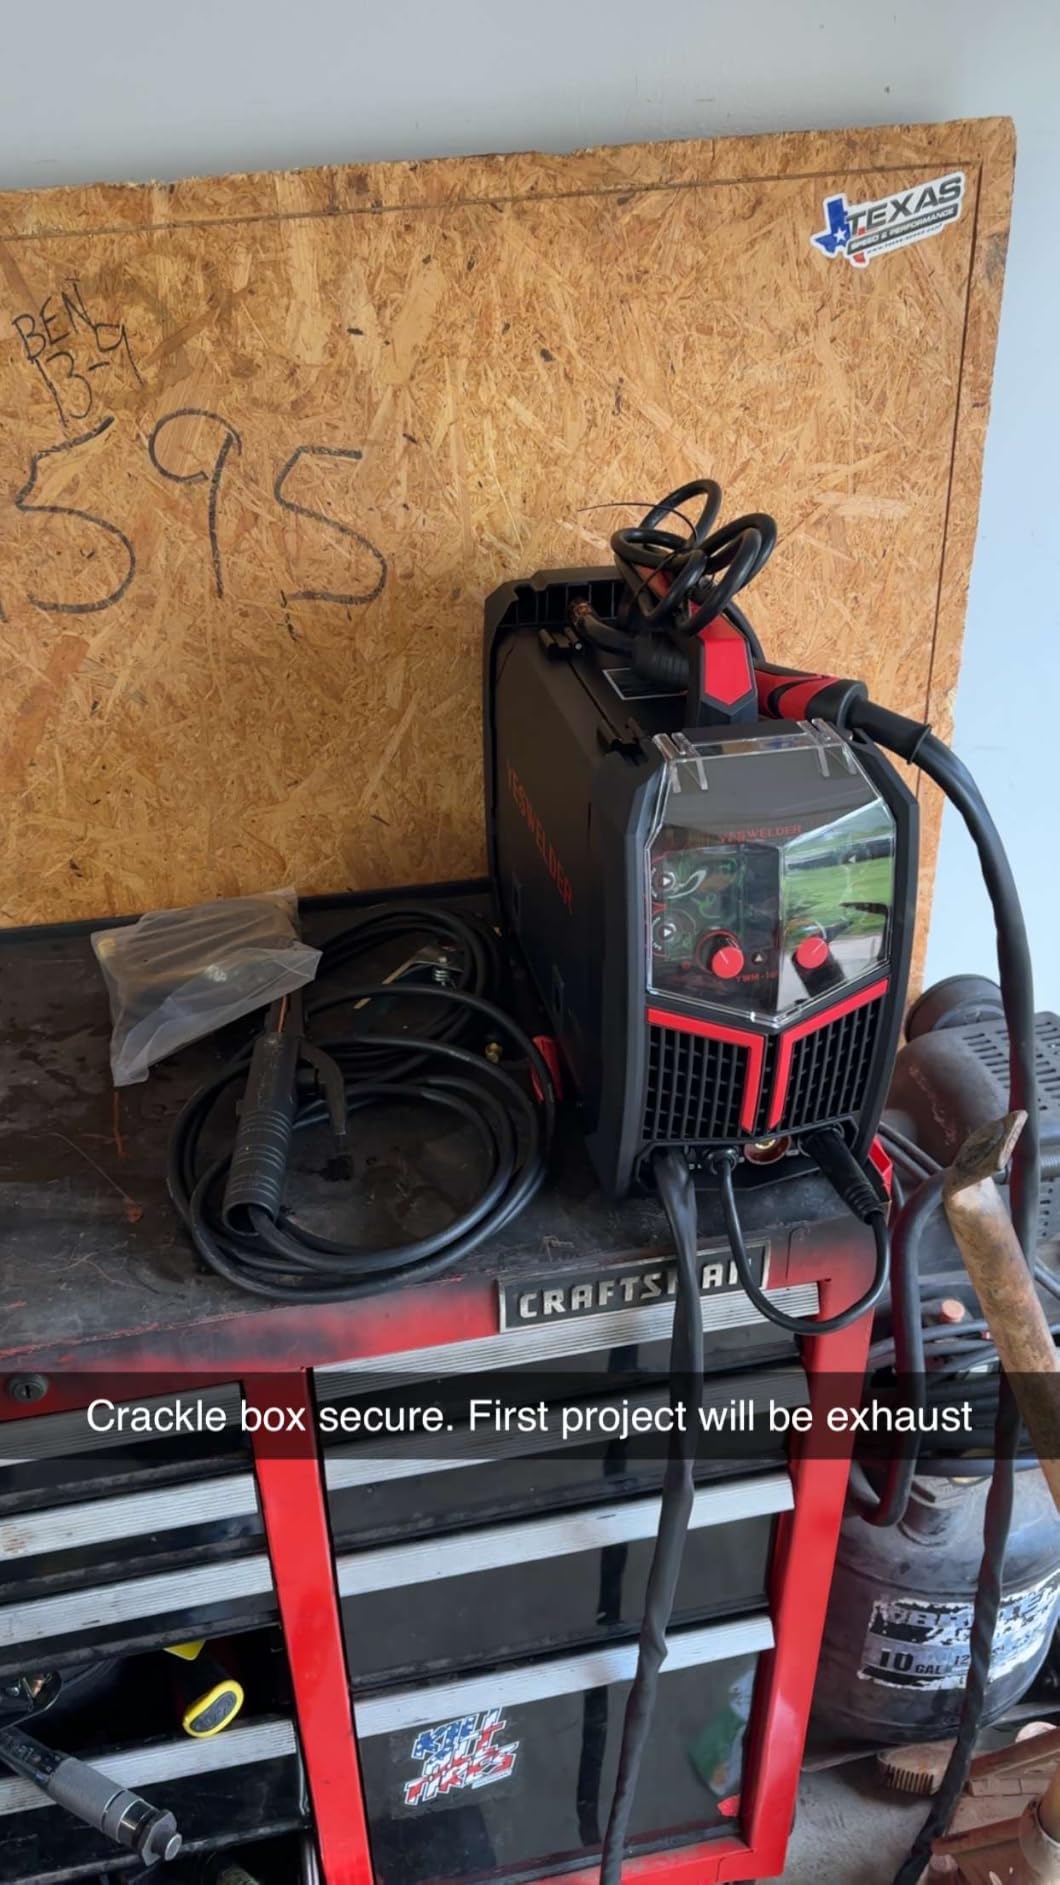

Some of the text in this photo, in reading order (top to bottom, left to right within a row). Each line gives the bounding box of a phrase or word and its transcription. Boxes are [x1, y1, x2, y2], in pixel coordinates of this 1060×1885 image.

[845, 176, 962, 235] TEXAS
[850, 207, 955, 251] SPEED & PERFORMANCE
[0, 407, 389, 623] 595
[878, 1648, 943, 1675] 10 GAL
